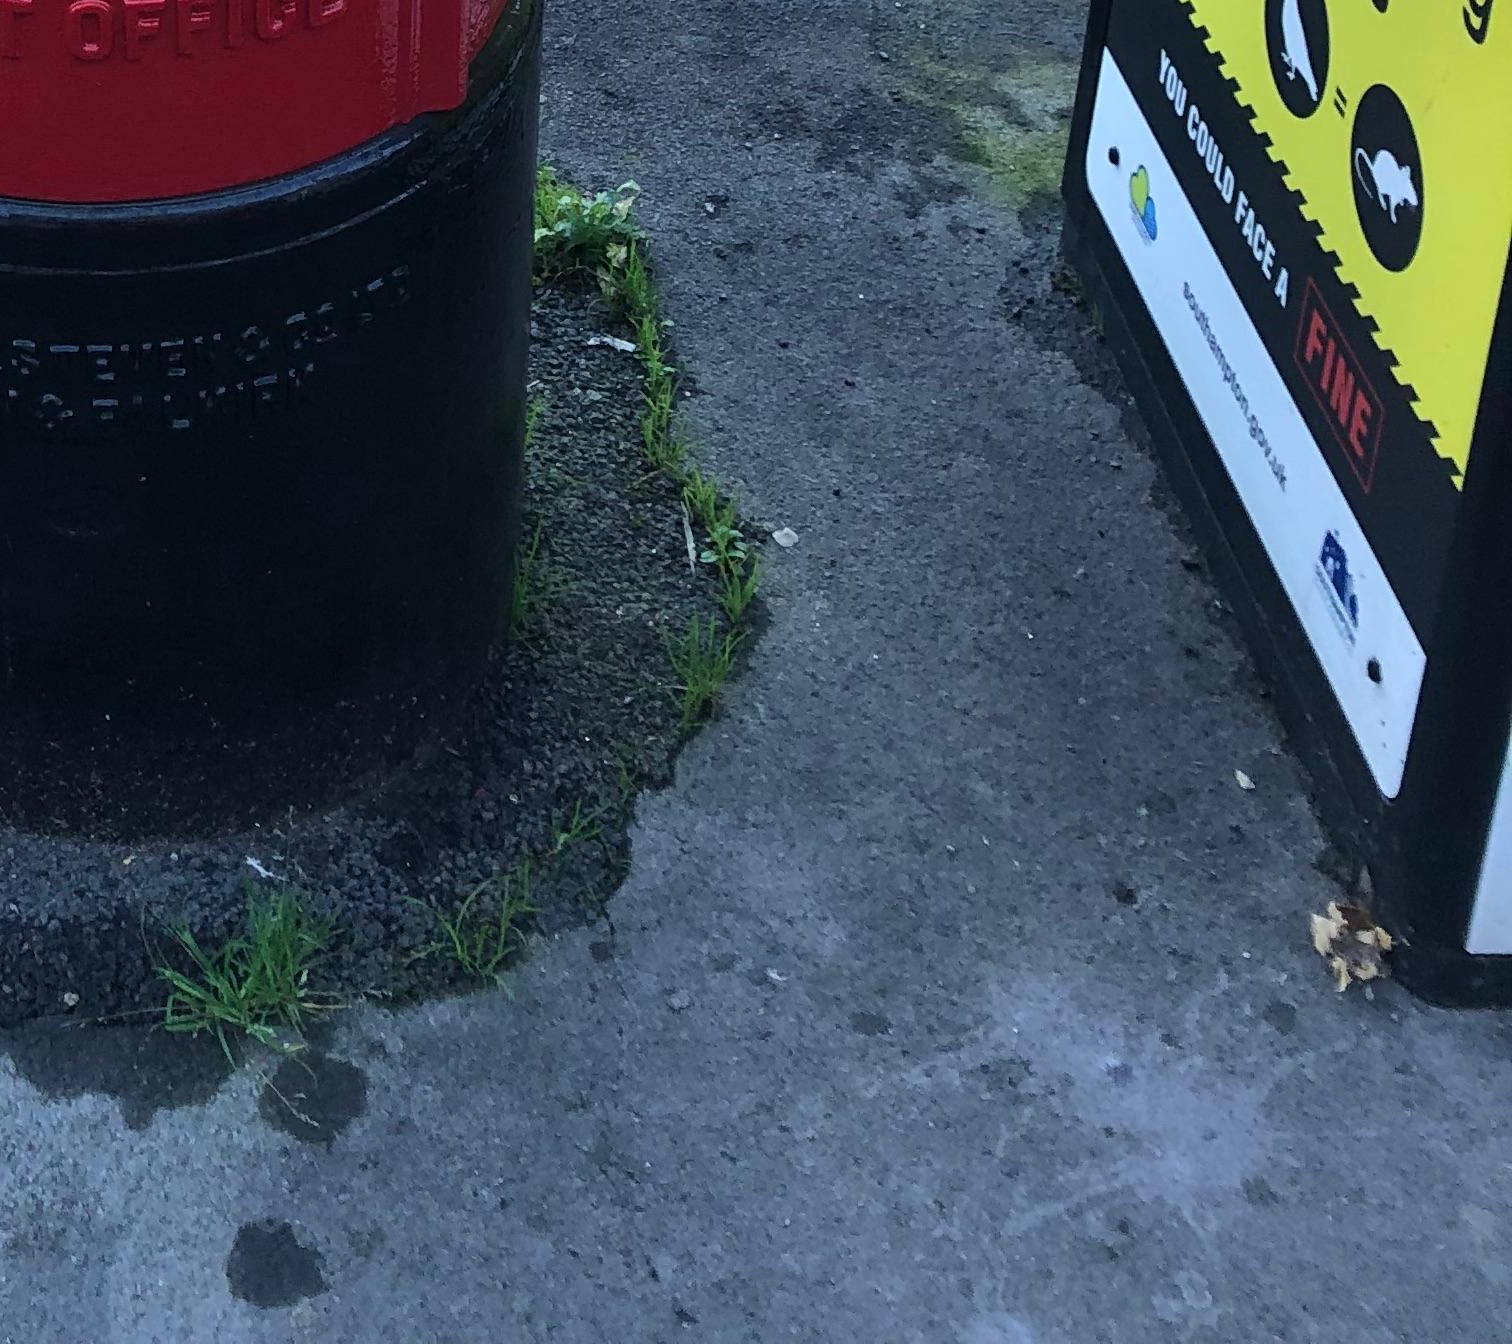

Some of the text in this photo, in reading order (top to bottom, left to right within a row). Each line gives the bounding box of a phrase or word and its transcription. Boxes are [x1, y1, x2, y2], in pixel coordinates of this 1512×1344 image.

[1158, 48, 1372, 459] YOU COULD FACE A FINE
